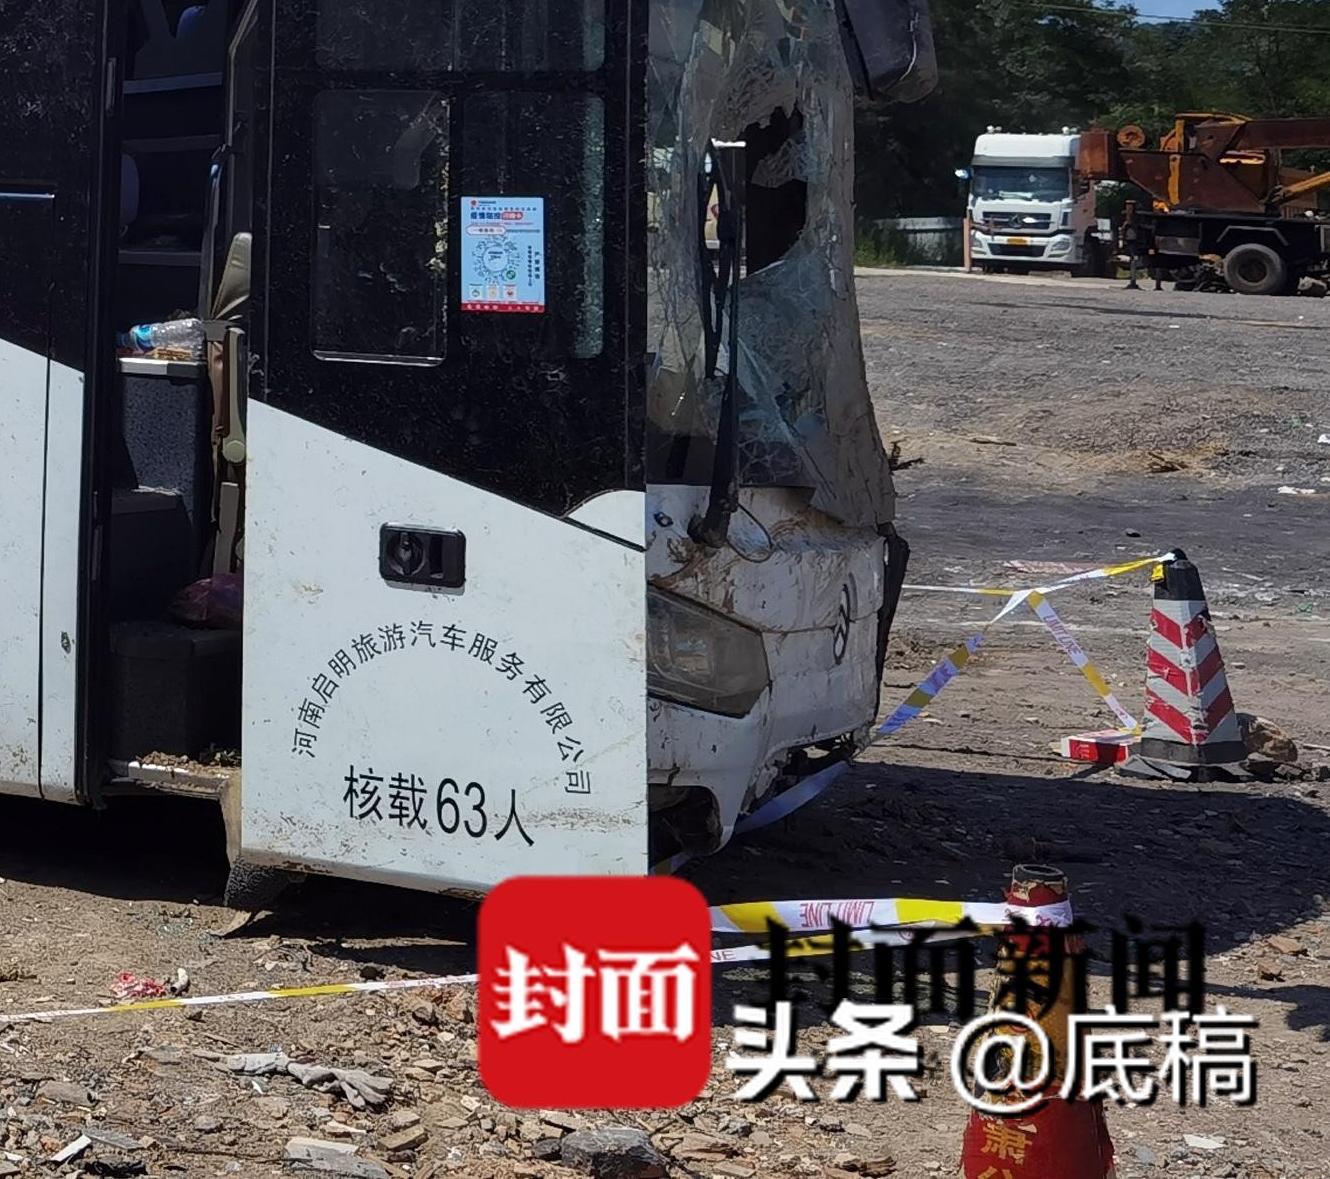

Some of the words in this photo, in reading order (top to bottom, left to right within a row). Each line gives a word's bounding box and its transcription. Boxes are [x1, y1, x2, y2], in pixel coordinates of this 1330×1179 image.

[291, 620, 590, 796] 河南启明旅游汽车服务有限公司
[343, 765, 535, 847] 核载63人
